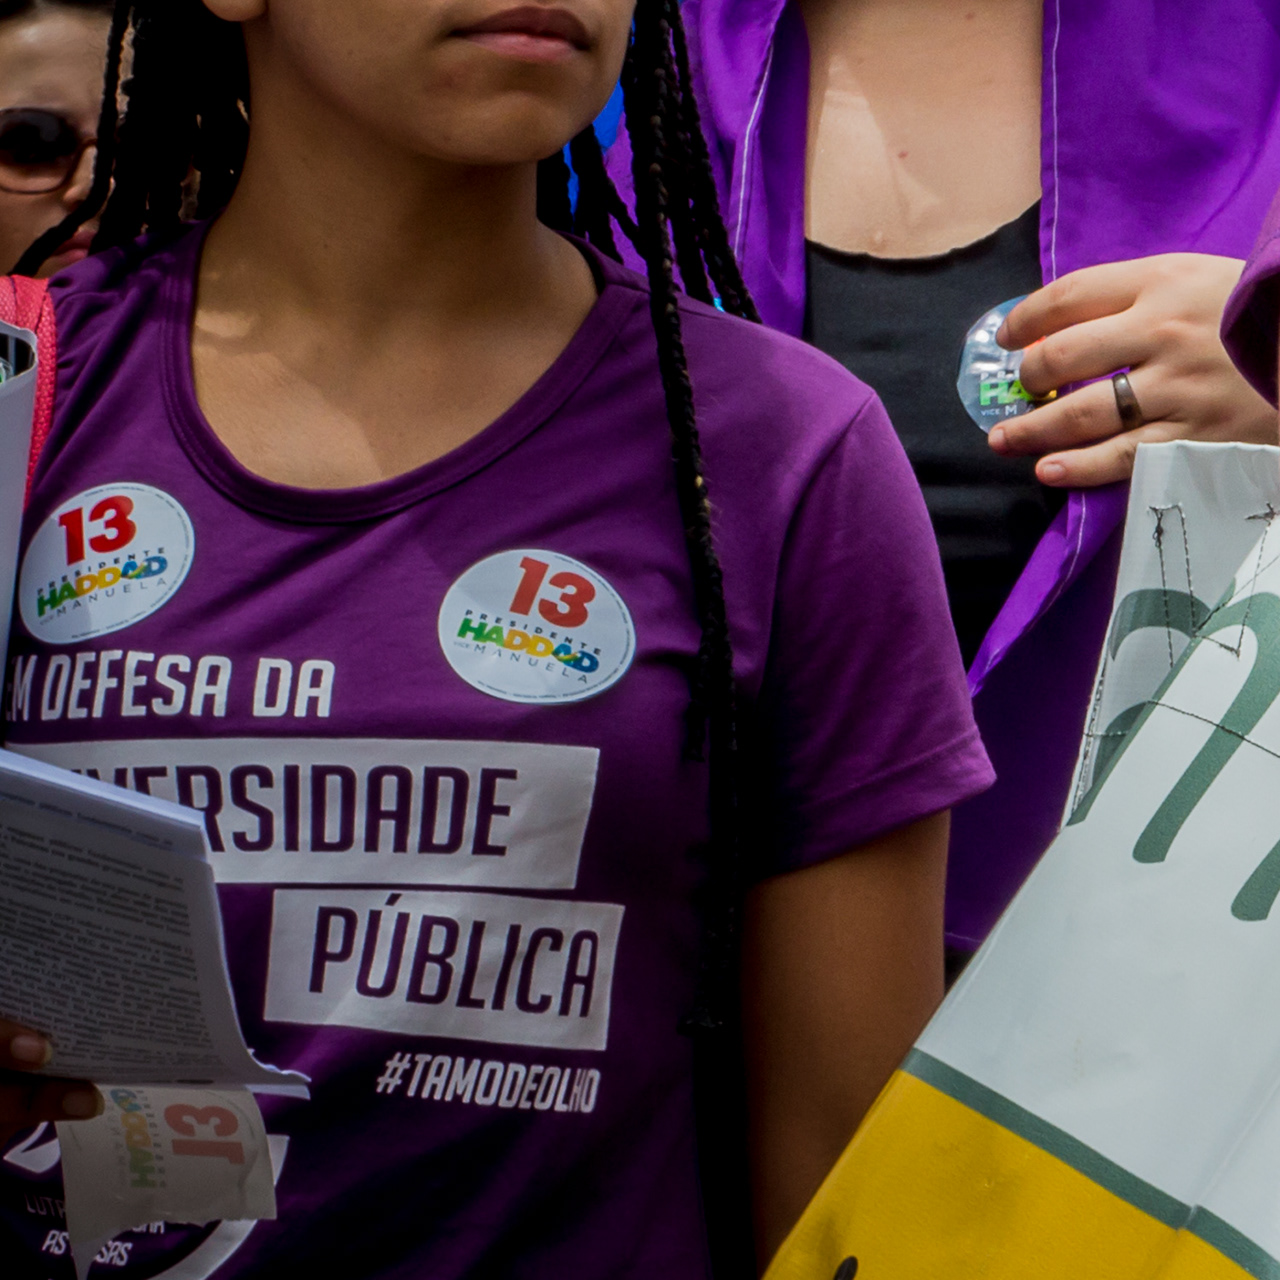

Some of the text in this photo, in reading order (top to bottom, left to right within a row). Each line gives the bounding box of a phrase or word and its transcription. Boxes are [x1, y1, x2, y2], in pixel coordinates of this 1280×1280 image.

[58, 495, 137, 566] 13
[36, 556, 169, 617] HADDAD
[37, 547, 165, 595] PRESIDENTE
[56, 577, 168, 616] MANUELA
[509, 556, 597, 629] 13
[457, 617, 600, 673] HADDAD
[465, 609, 602, 656] PRESIDENTE
[41, 649, 233, 721] DEFESA
[252, 657, 336, 717] DA
[473, 643, 589, 684] MANUELA
[308, 892, 600, 1018] PÚBLICA
[375, 1052, 602, 1113] #TAMODEOLHO
